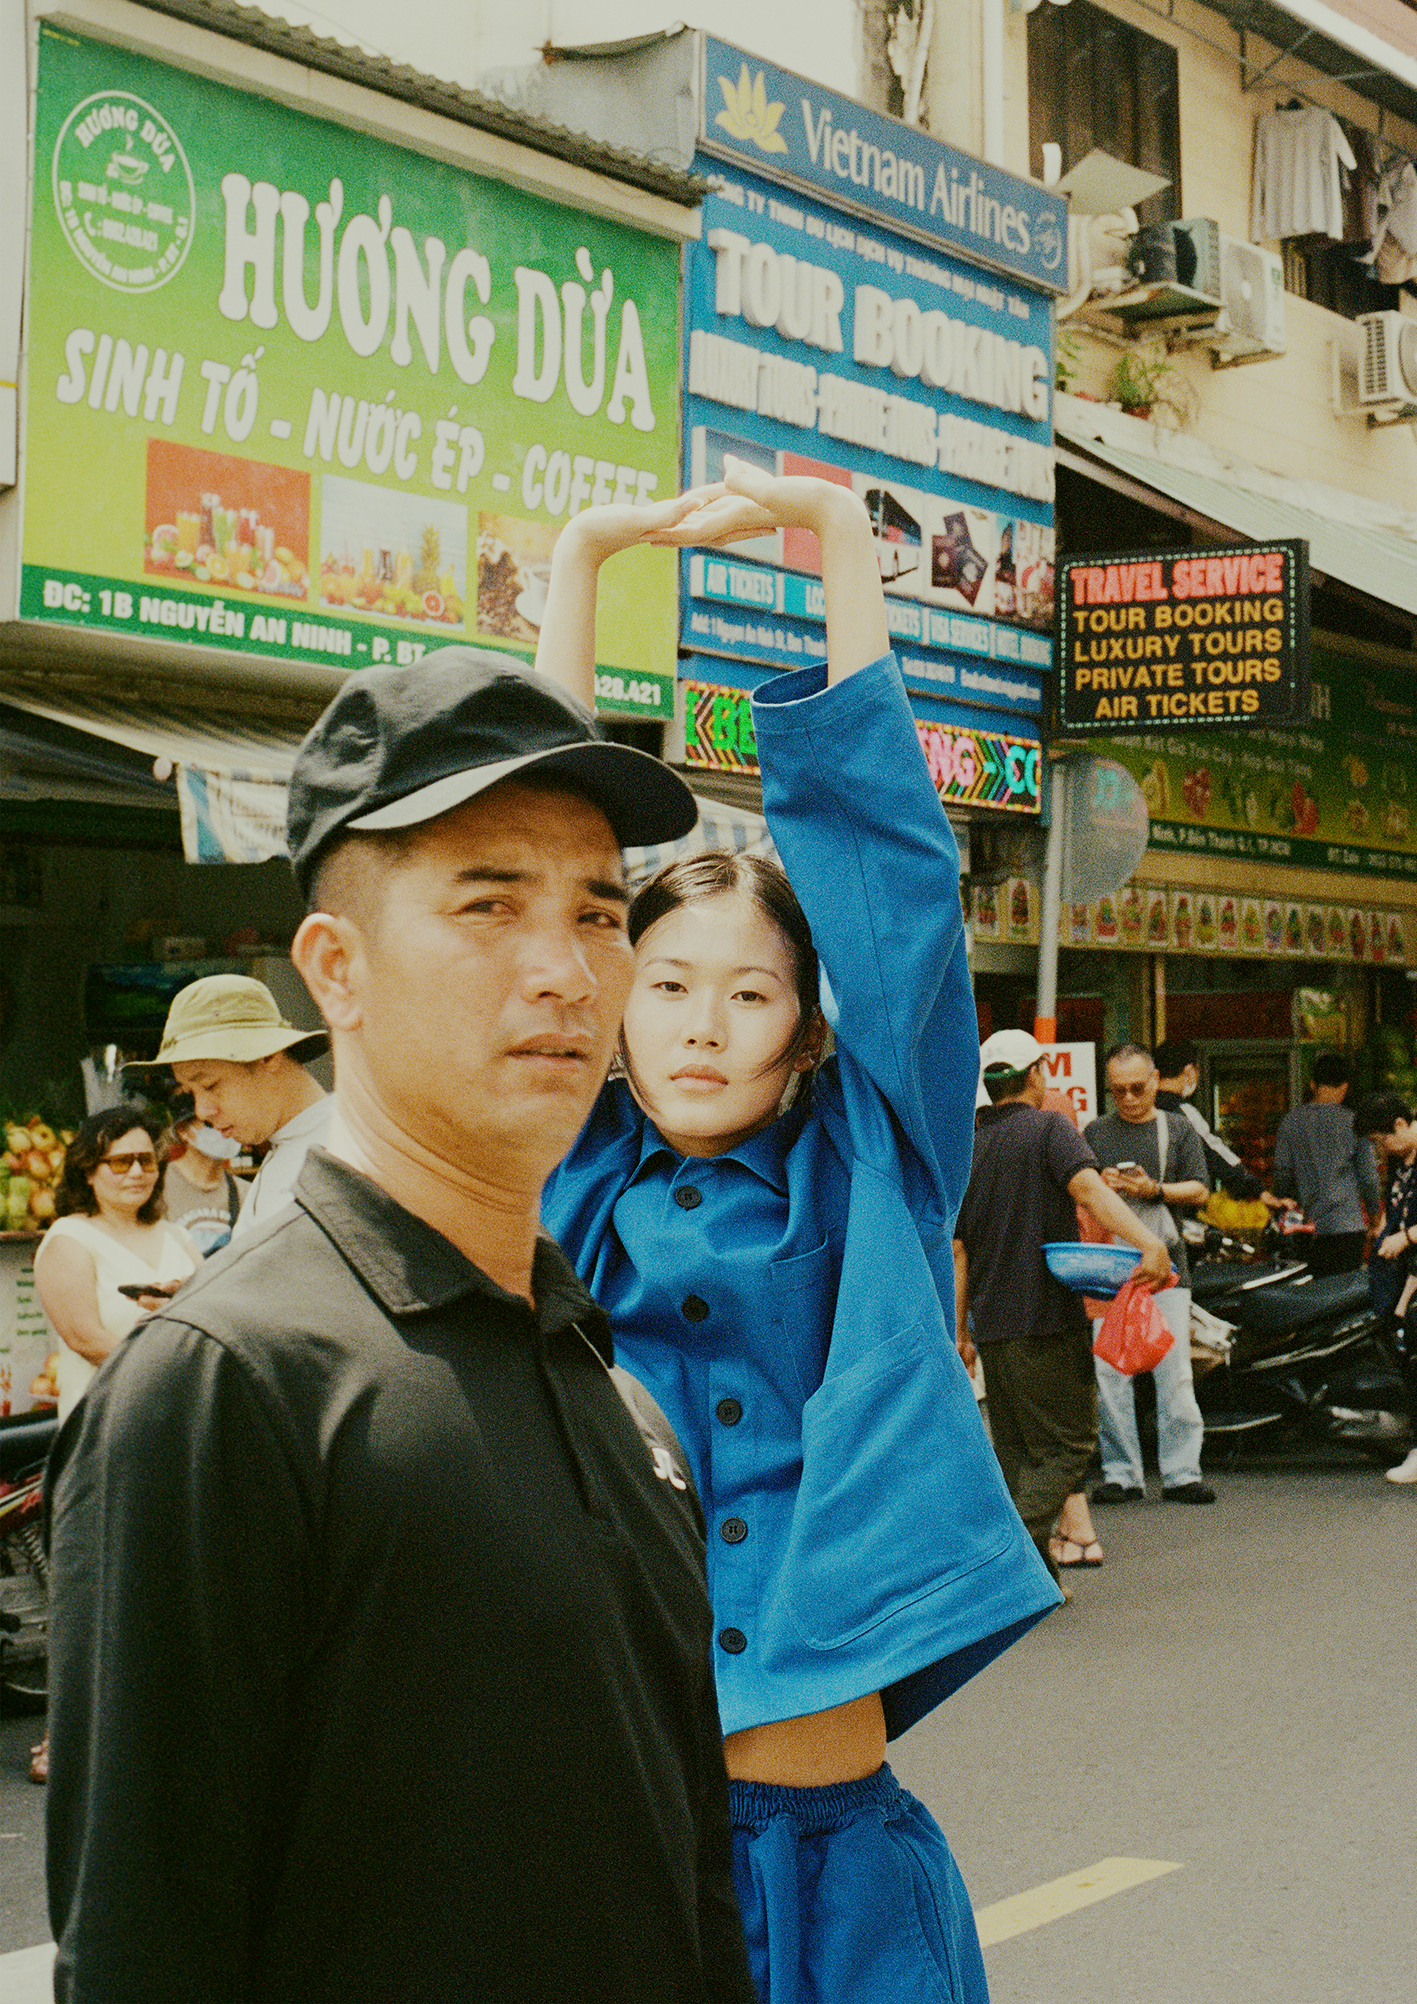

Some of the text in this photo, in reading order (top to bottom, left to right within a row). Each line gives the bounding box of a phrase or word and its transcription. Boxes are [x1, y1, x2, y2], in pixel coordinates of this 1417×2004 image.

[802, 99, 1030, 254] Vietnam Airlines
[219, 173, 495, 385] HƯƠNG
[513, 246, 656, 432] DỪA
[707, 227, 1049, 422] TOUR BOOKING
[56, 331, 185, 426] SINH
[200, 345, 265, 443] TỐ
[303, 387, 421, 481] NƯỚC
[431, 404, 485, 494] ÉP
[1070, 552, 1284, 606] TRAVEL SERVICE
[43, 579, 91, 613] ĐC:
[98, 590, 134, 618] 1B
[249, 615, 286, 645] AN
[291, 622, 352, 657] NINH
[372, 637, 391, 662] P.
[1073, 598, 1284, 633] TOUR BOOKING
[1074, 633, 1181, 662] LUXURY
[1188, 627, 1283, 656] TOURS
[1075, 663, 1185, 691] PRIVATE
[1191, 657, 1282, 685] TOURS
[1095, 688, 1260, 719] AIR TICKETS
